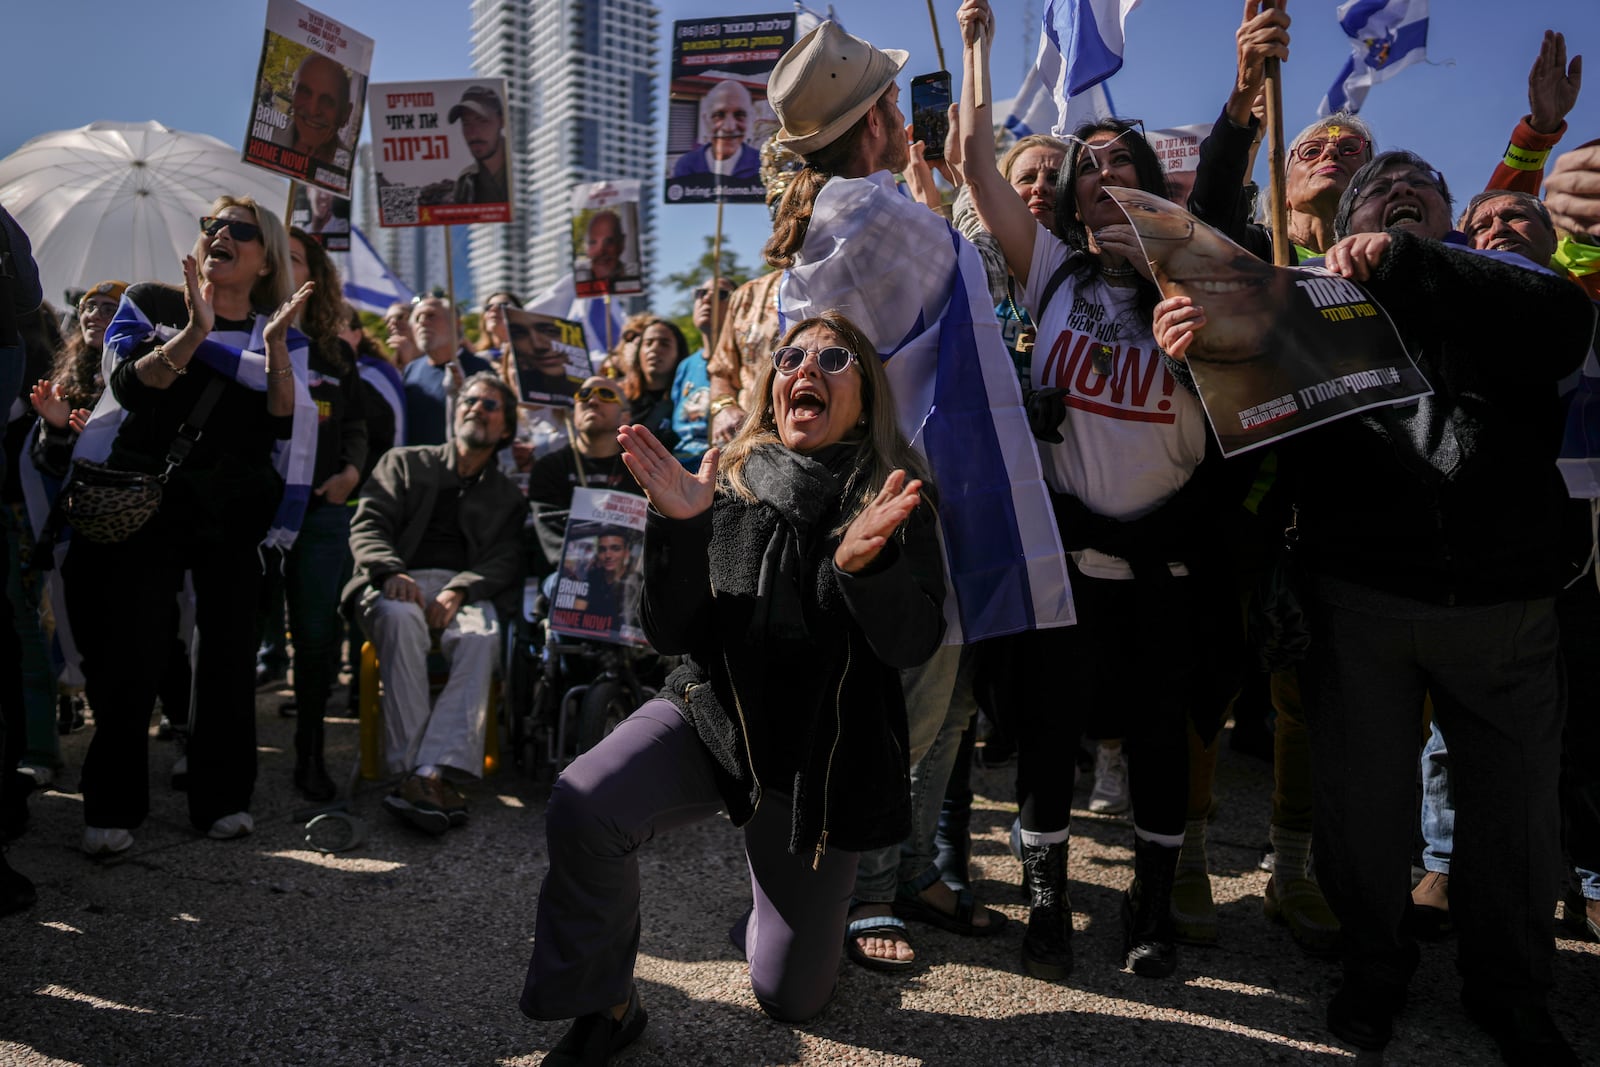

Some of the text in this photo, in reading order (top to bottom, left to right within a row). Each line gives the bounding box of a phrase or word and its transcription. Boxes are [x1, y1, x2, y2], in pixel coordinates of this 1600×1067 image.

[386, 92, 435, 109] מחזירים
[255, 104, 289, 130] BRING
[385, 112, 439, 130] את איתי
[251, 120, 275, 142] HIM
[382, 135, 449, 162] הביתה
[1165, 138, 1178, 148] דקל
[1167, 148, 1187, 158] DEKEL
[248, 137, 280, 163] HOME
[280, 149, 310, 173] NOW!
[1168, 158, 1182, 169] (35)
[1295, 277, 1368, 308] מאחור
[1070, 298, 1105, 321] BRING
[1066, 313, 1096, 335] THEM
[1041, 328, 1177, 411] NOW!
[558, 577, 590, 597] BRING
[554, 593, 577, 610] HIM
[552, 609, 614, 631] HOME NOW!
